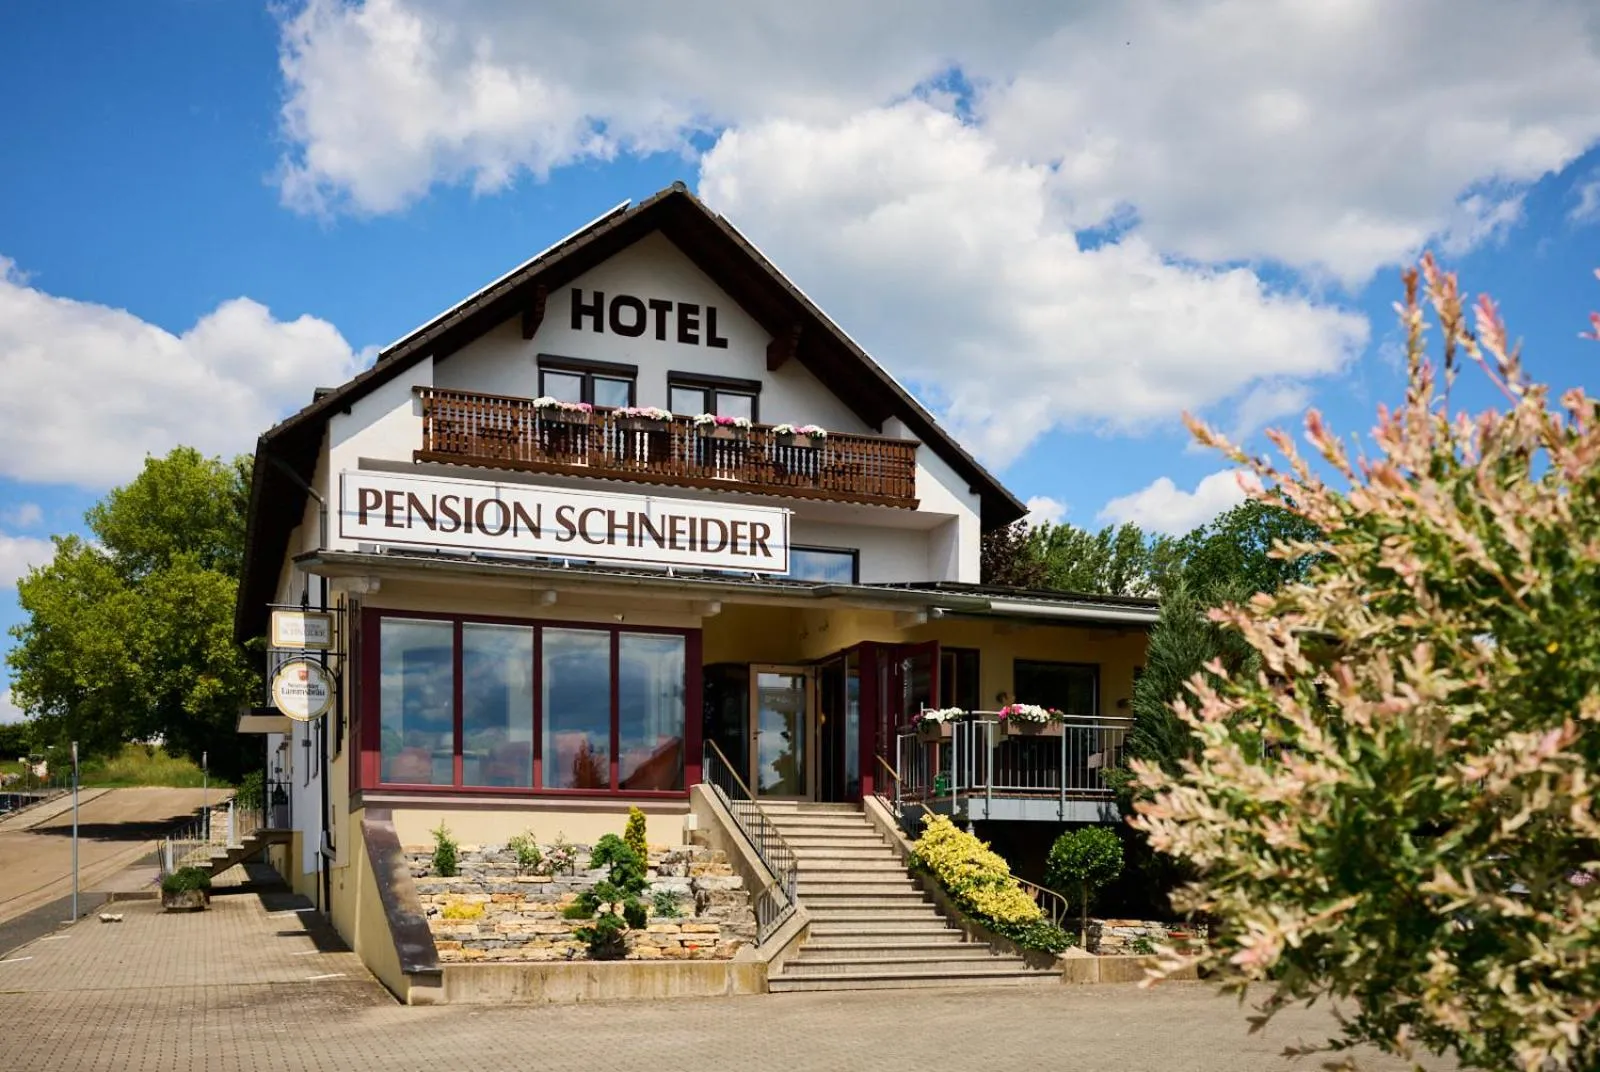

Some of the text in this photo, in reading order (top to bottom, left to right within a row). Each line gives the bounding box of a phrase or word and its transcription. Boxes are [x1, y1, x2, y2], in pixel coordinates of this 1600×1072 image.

[571, 288, 728, 349] HOTEL
[358, 487, 774, 559] PENSION SCHNEIDER
